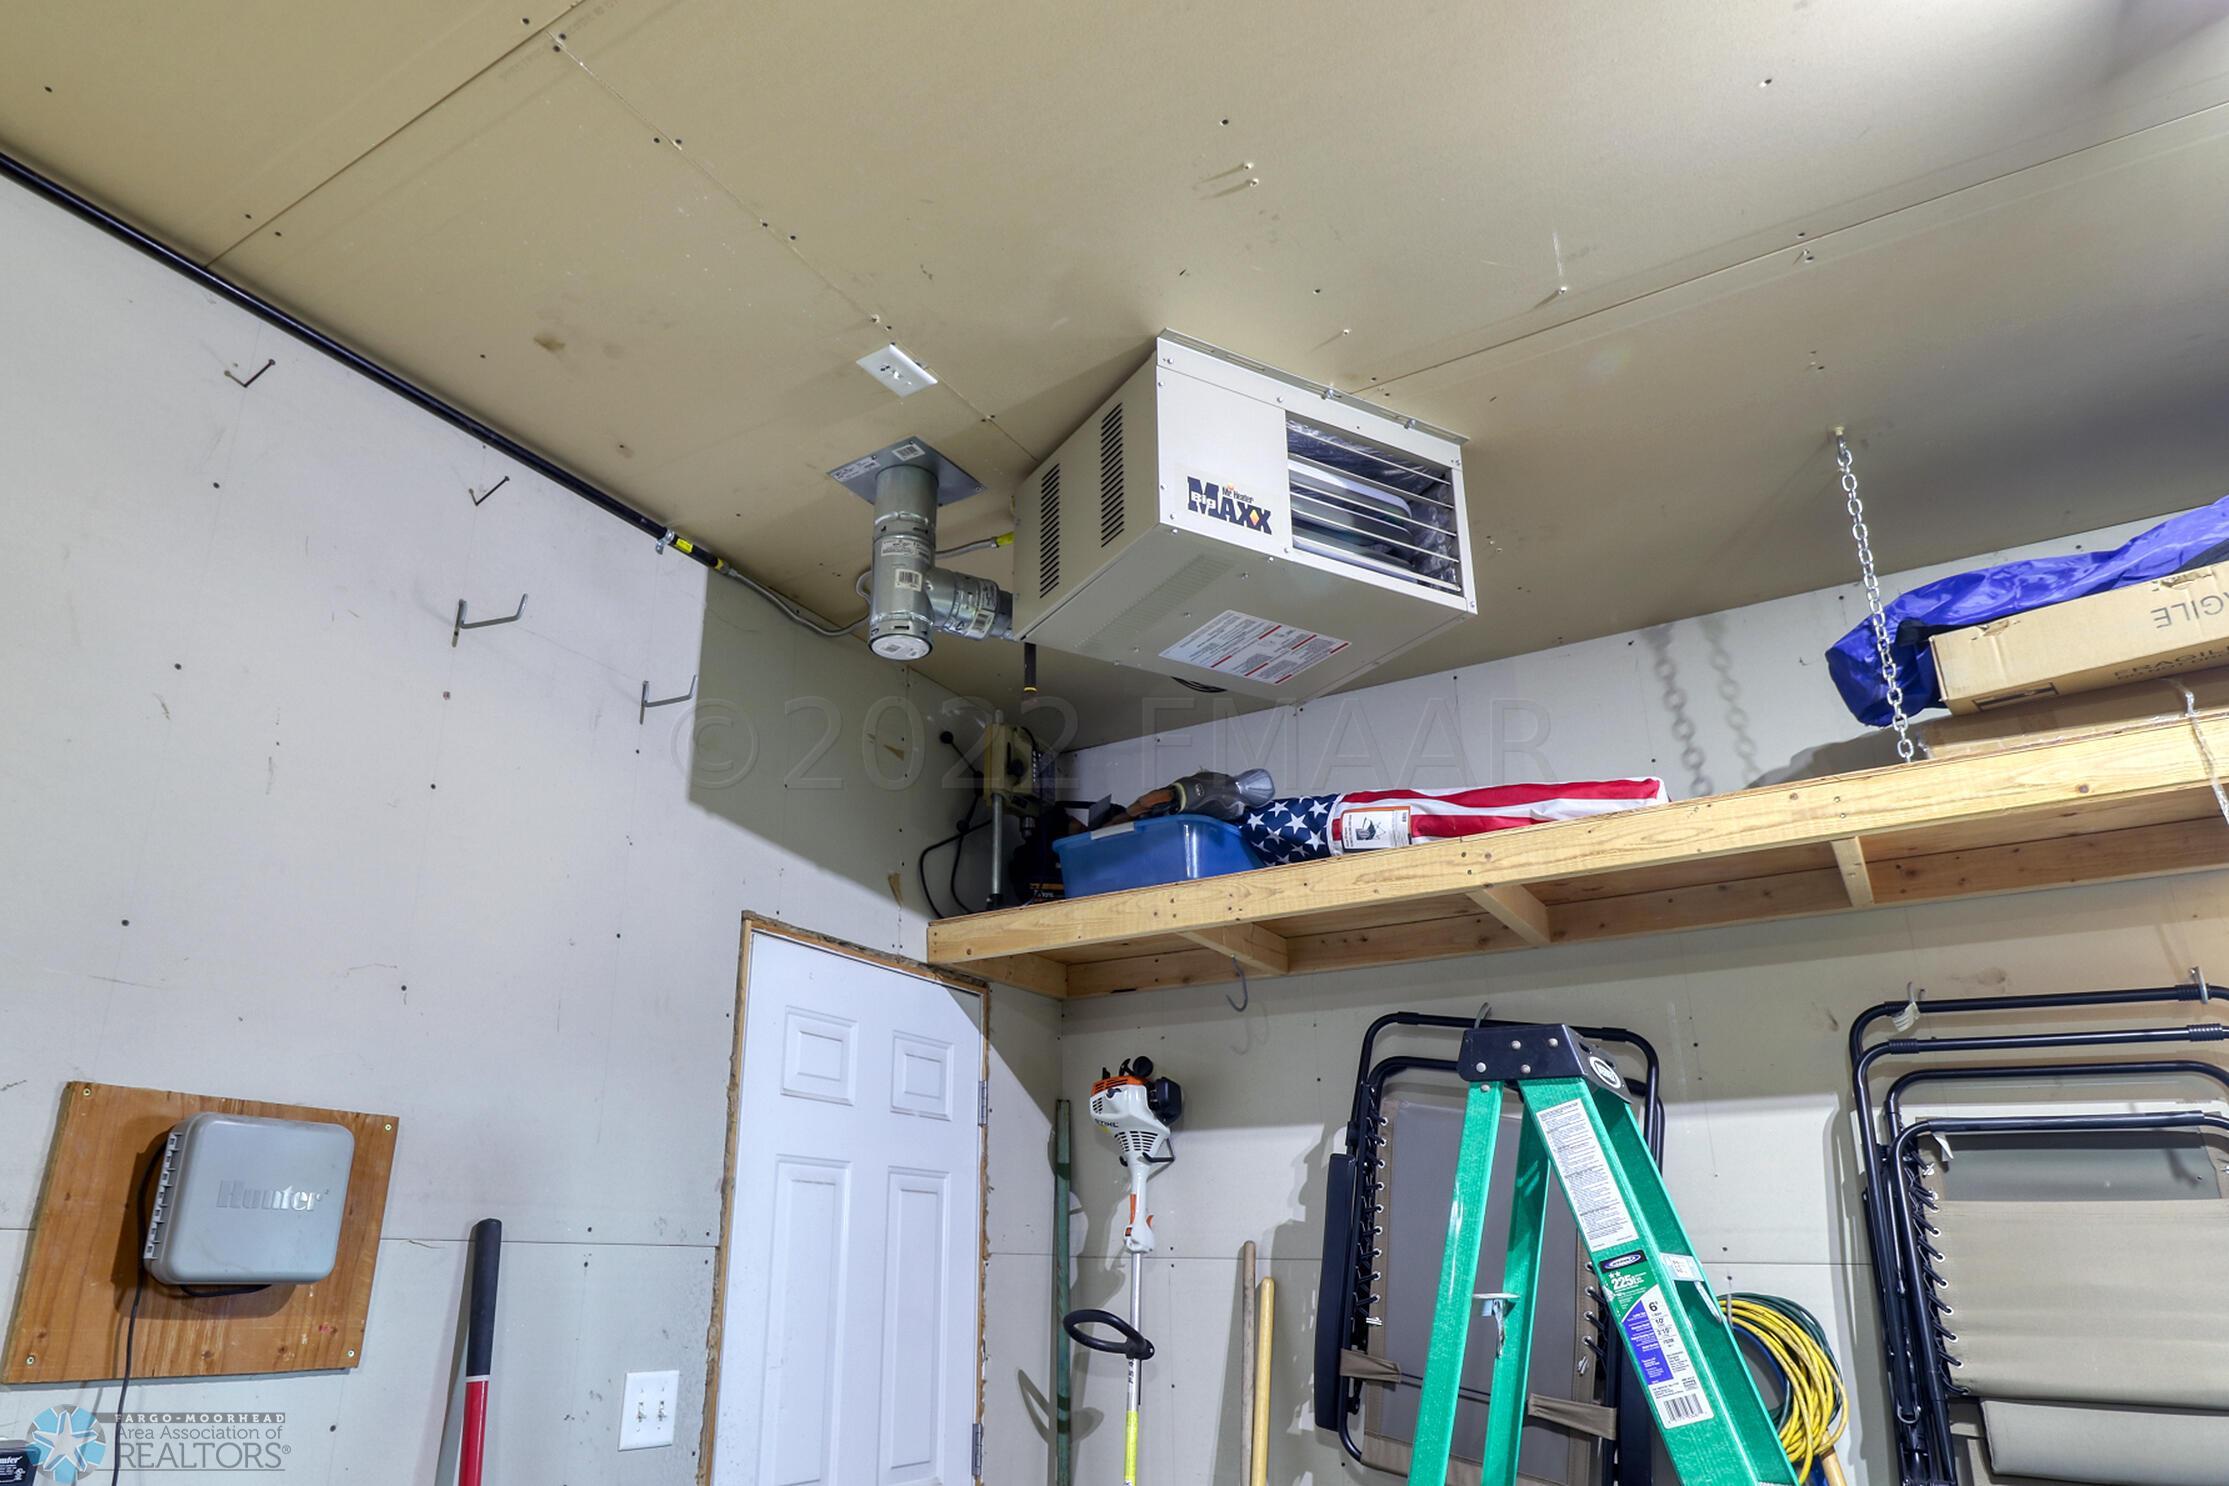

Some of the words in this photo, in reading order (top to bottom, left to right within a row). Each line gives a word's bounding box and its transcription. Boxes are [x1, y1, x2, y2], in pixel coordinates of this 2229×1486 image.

[1187, 476, 1272, 535] MAXX
[1191, 491, 1217, 510] Big
[2150, 591, 2229, 629] GILE
[216, 1179, 321, 1212] Hunter
[1611, 1274, 1633, 1290] 225
